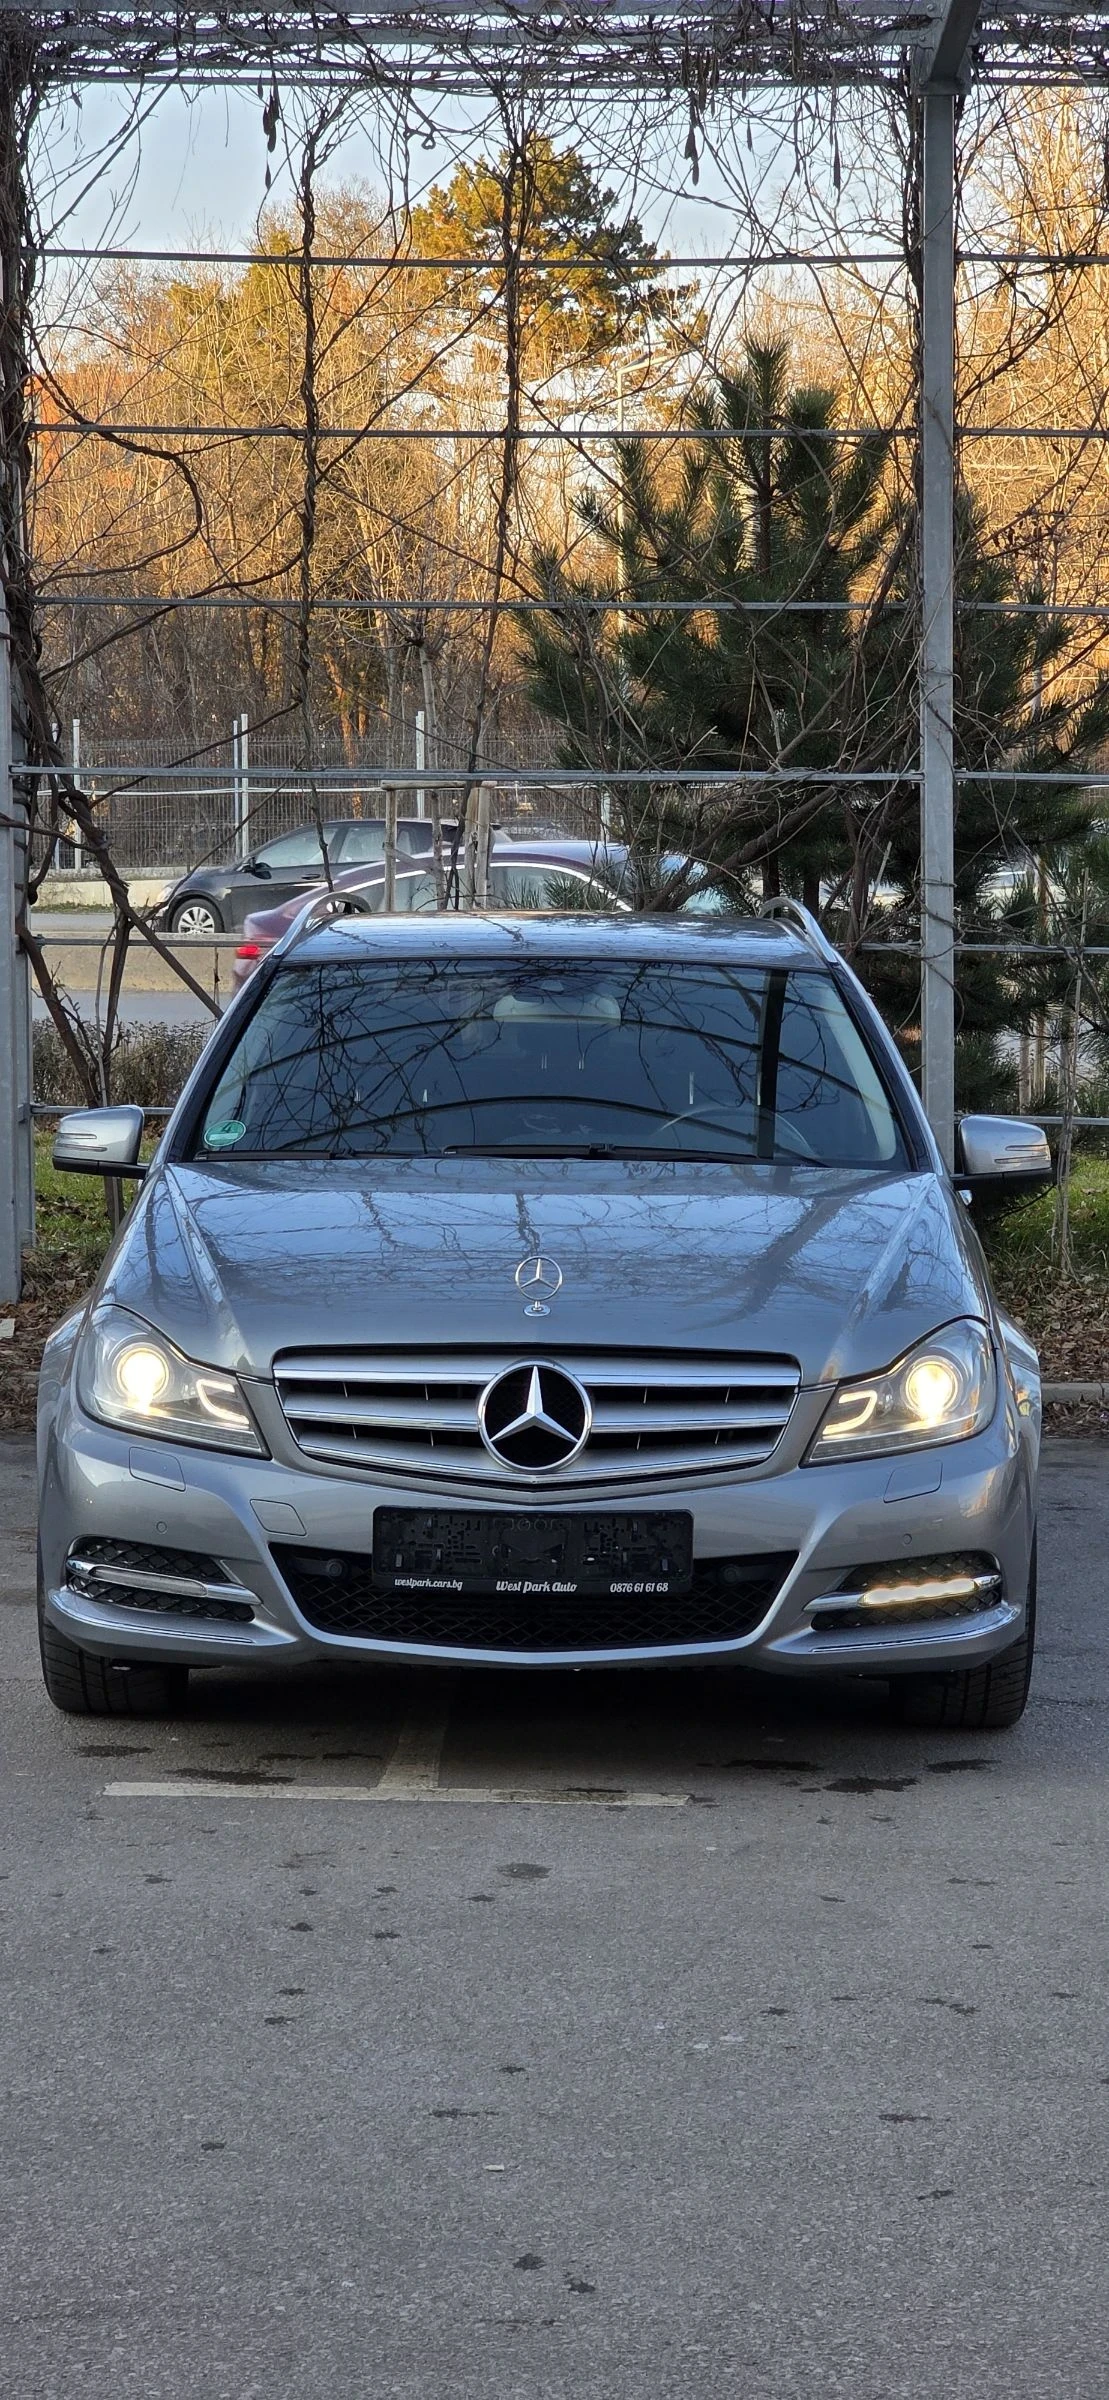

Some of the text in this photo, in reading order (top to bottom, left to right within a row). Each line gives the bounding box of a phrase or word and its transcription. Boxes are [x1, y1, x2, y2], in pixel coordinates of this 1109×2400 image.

[221, 1122, 232, 1133] 4
[394, 1578, 463, 1591] westpark.cars.bg
[496, 1581, 577, 1593] West Park Auto
[610, 1582, 669, 1593] 0876 61 61 68
